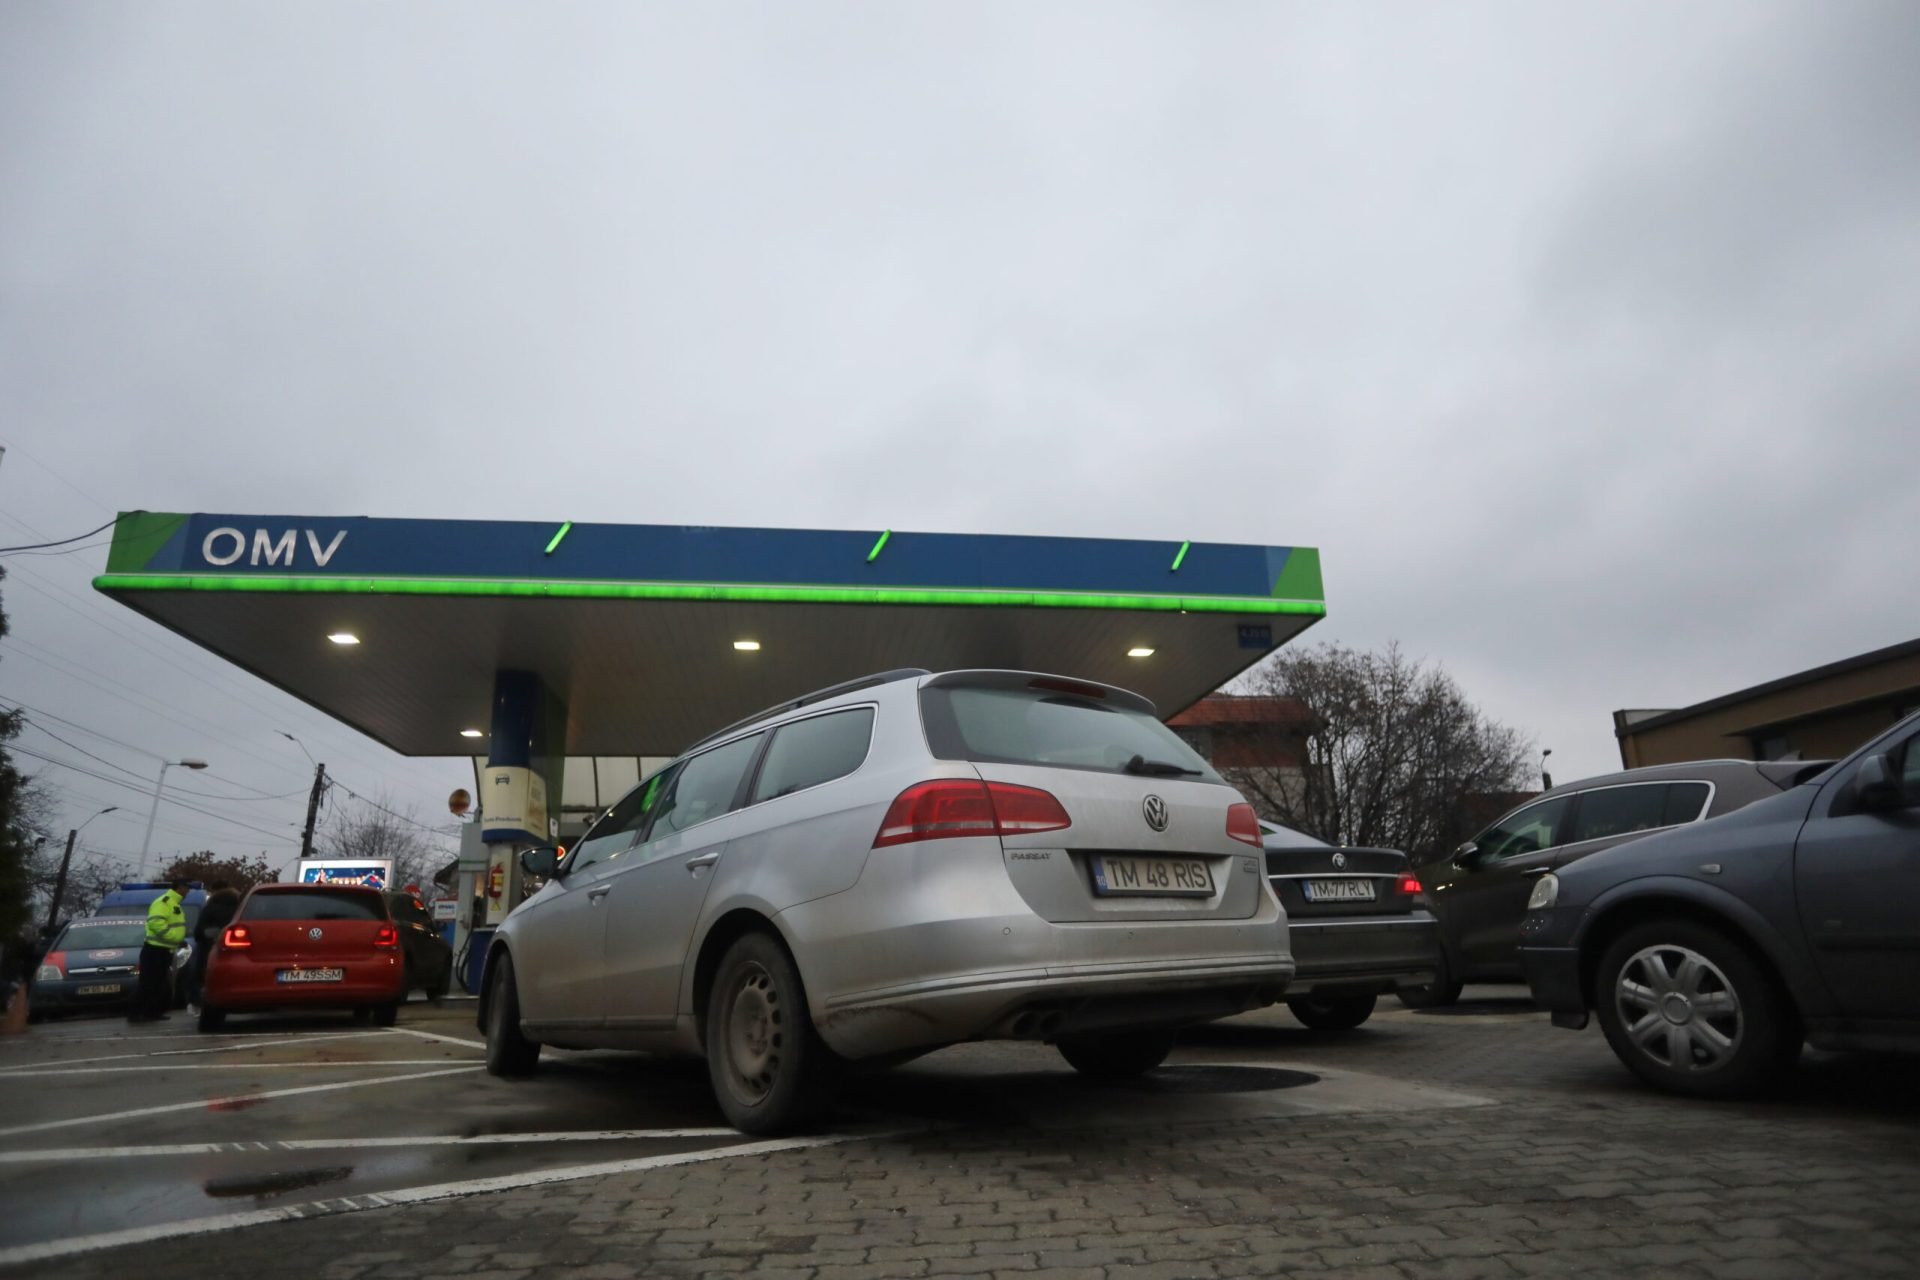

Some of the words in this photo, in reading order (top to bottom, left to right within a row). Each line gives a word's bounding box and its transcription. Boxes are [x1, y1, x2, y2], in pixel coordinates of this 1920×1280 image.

[202, 527, 347, 567] OMV
[1106, 860, 1141, 887] TM
[1146, 861, 1170, 888] 48
[1173, 862, 1208, 889] RIS
[1310, 881, 1330, 897] TM
[286, 971, 300, 980] TM
